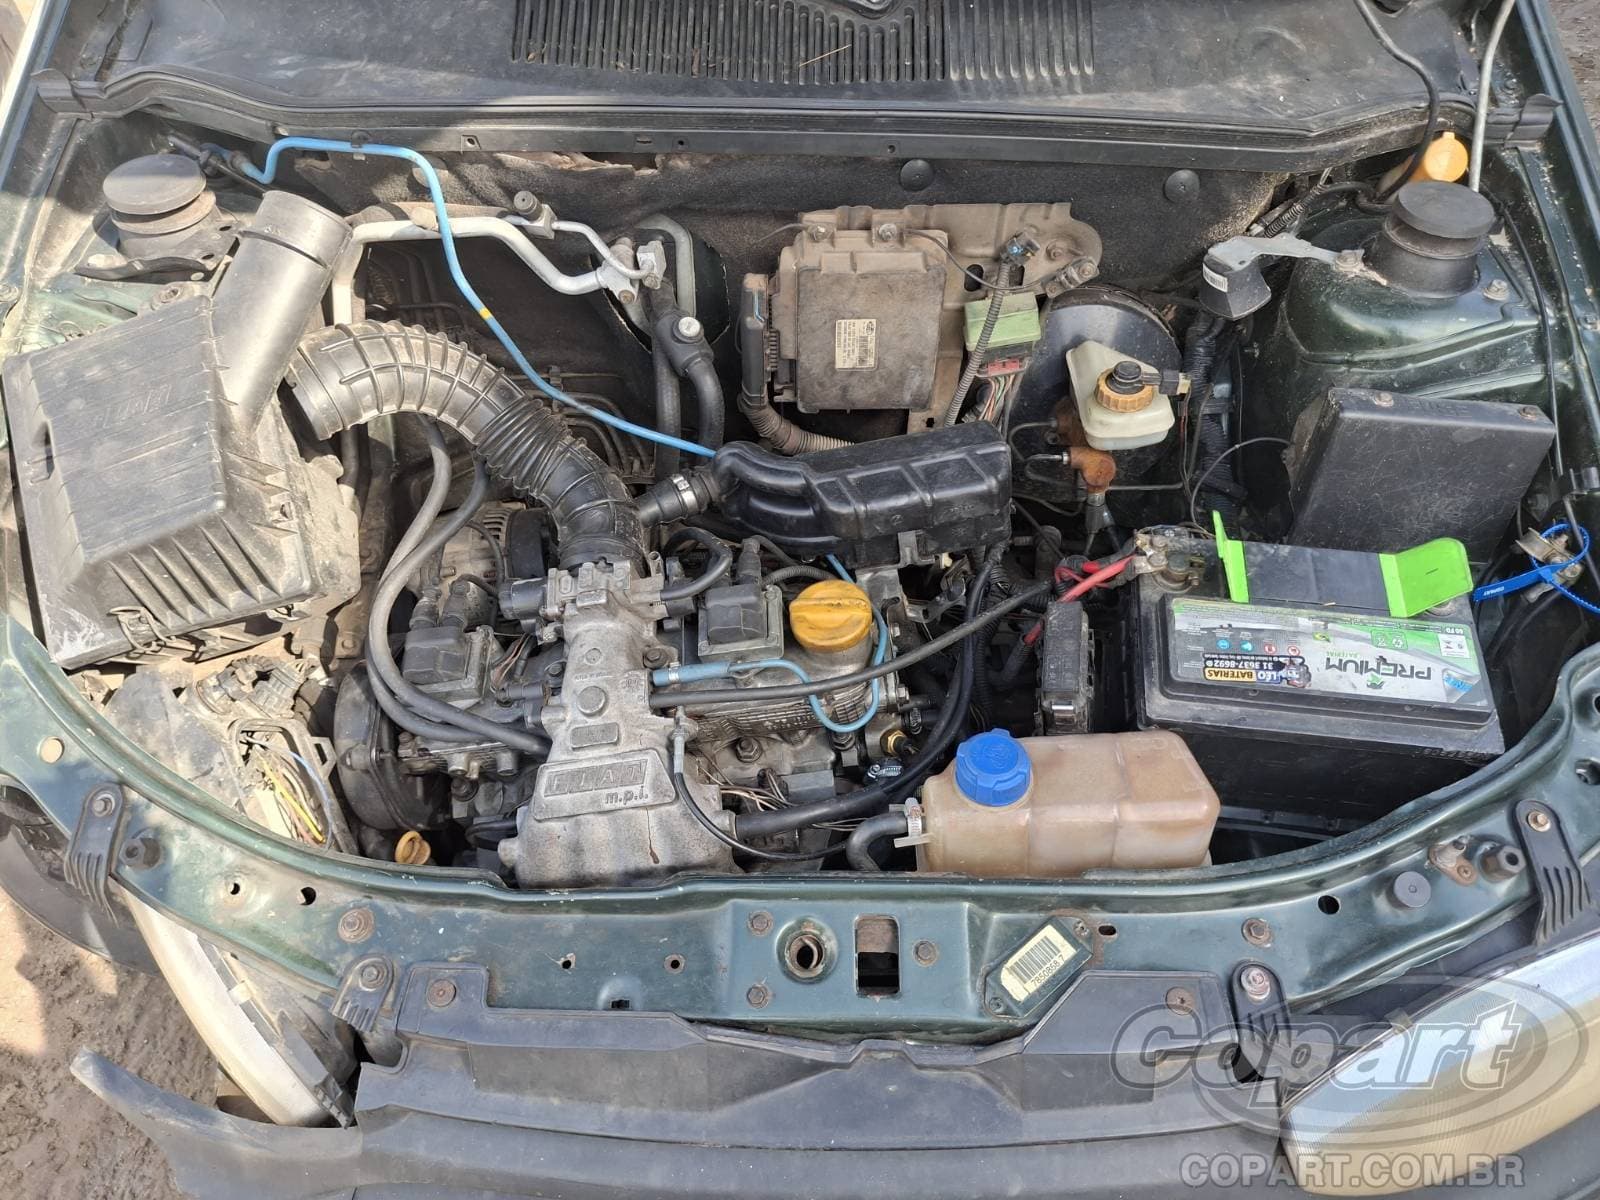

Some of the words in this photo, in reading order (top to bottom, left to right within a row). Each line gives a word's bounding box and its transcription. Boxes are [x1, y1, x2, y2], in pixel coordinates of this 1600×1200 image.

[1262, 661, 1274, 670] 31
[1325, 657, 1432, 681] PREMIUM
[1207, 669, 1254, 681] BATERIAS
[1258, 670, 1277, 683] LÉO
[549, 761, 644, 795] FIAT
[605, 786, 648, 805] m.p.i.
